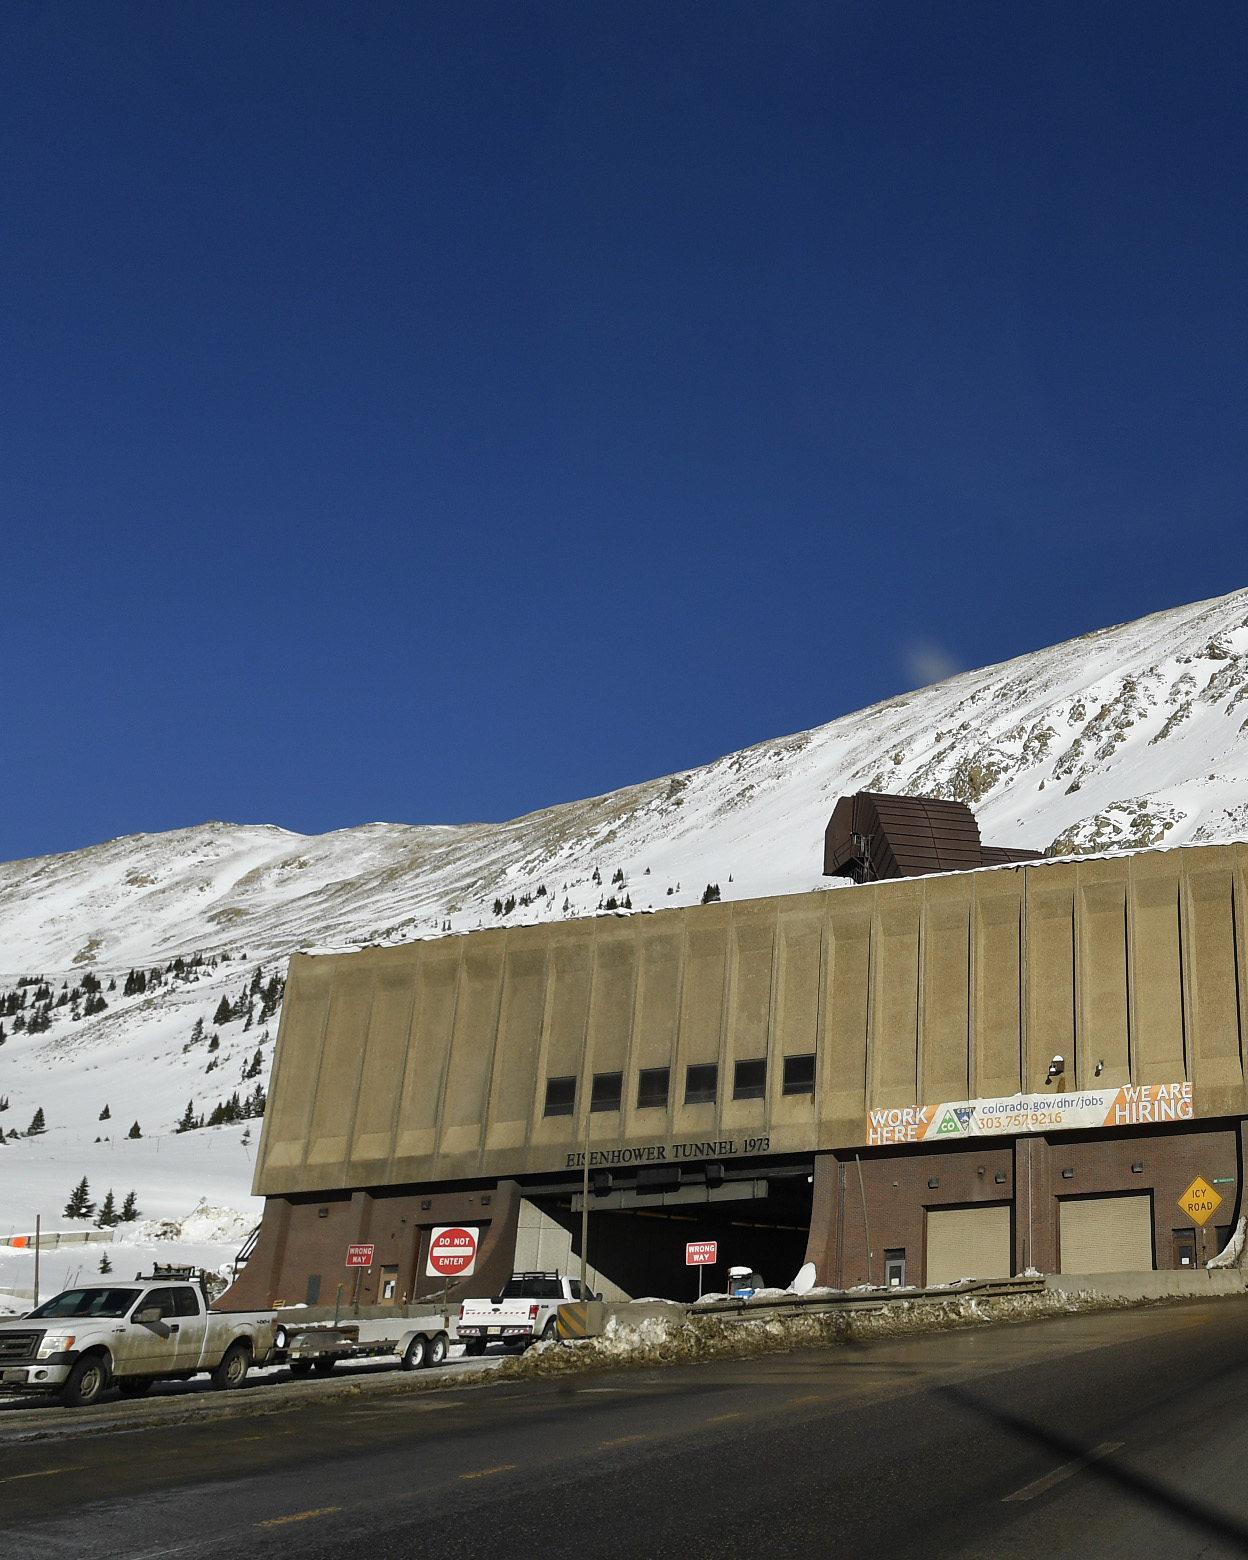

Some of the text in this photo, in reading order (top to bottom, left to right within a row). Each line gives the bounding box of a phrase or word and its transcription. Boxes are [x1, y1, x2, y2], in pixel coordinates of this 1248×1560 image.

[1123, 1081, 1193, 1103] WE ARE
[982, 1096, 1104, 1114] colorado.gov/dhr/jobs
[1115, 1097, 1193, 1125] HIRING
[869, 1105, 929, 1128] WORK
[940, 1122, 955, 1131] CO
[869, 1124, 918, 1145] HERE
[672, 1140, 738, 1159] TUNNEL
[743, 1137, 770, 1153] 1973
[1192, 1189, 1207, 1198] ICY
[1187, 1202, 1213, 1212] ROAD
[350, 1247, 372, 1255] WRONG
[688, 1245, 715, 1253] WRONG
[439, 1258, 464, 1266] ENTER
[693, 1253, 710, 1261] WAY
